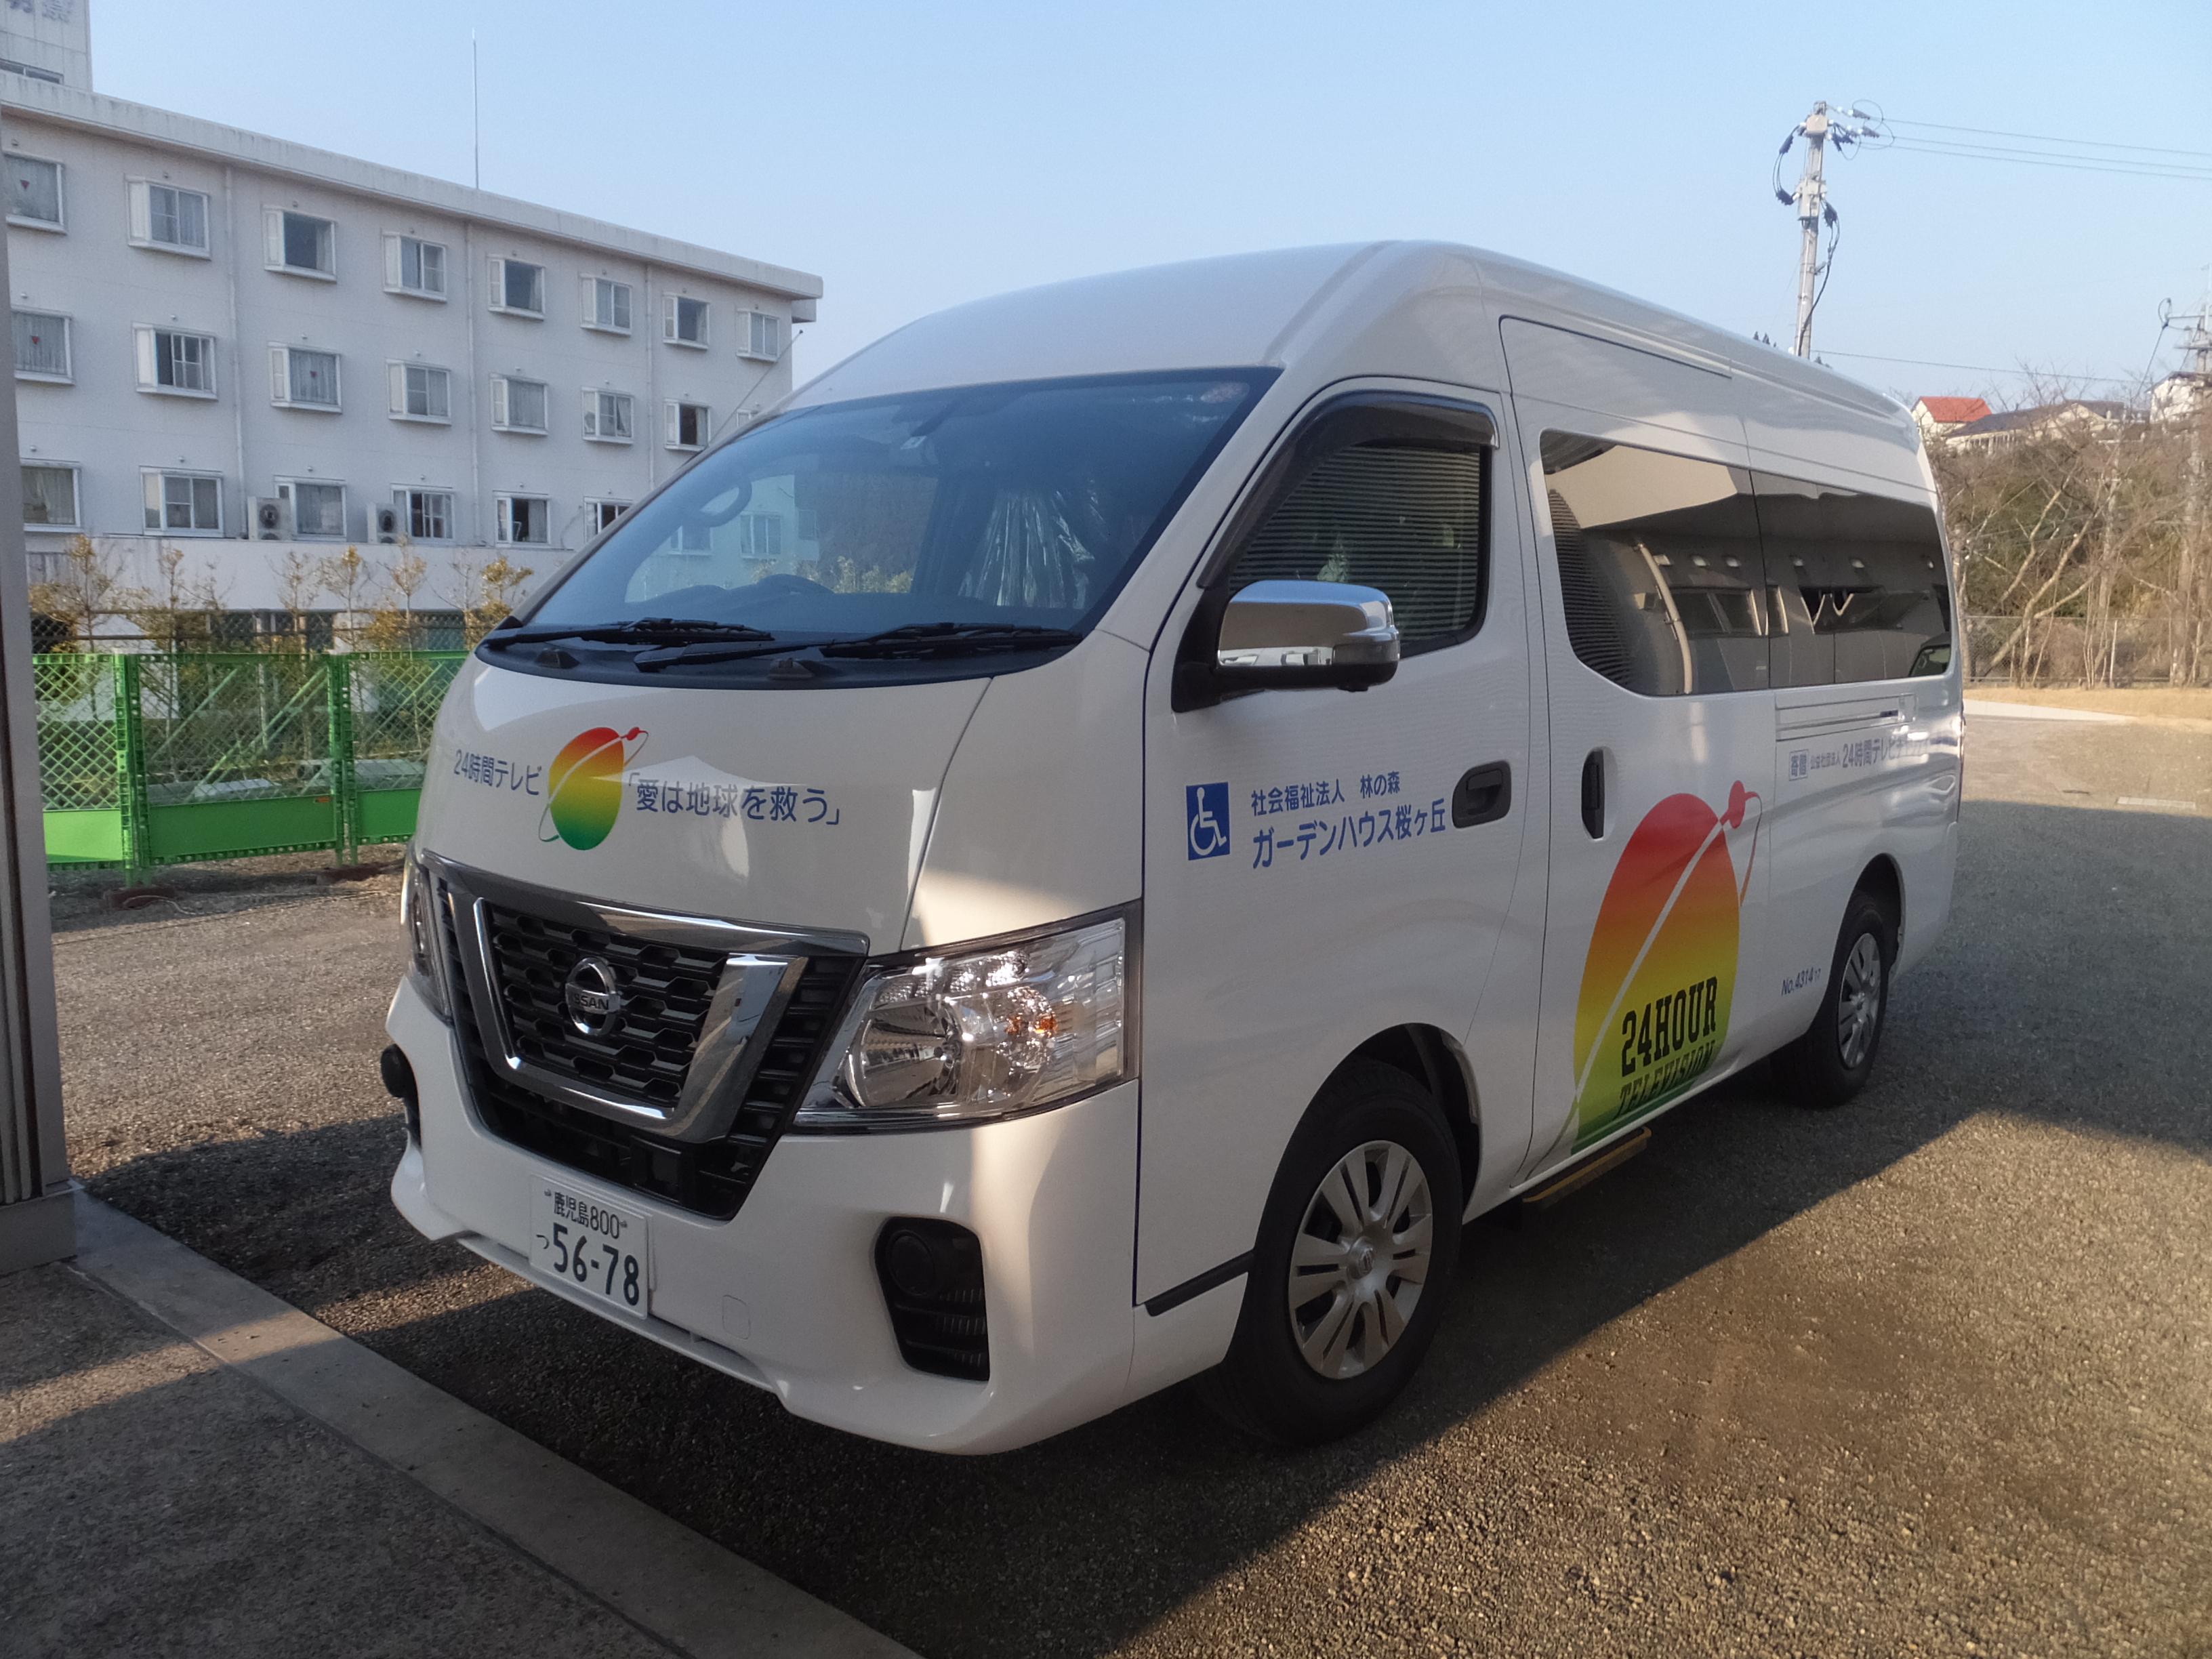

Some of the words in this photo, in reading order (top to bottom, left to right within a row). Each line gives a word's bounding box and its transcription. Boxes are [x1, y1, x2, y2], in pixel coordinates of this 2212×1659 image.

[453, 748, 542, 796] 24時間テレビ
[628, 771, 840, 825] 「愛は地球を救う」
[1251, 778, 1345, 816] 社会福祉法人
[1359, 771, 1401, 799] 林の森
[569, 991, 609, 1010] SSAN
[1621, 976, 1718, 1078] 24HOUR
[553, 1222, 640, 1307] 56-78
